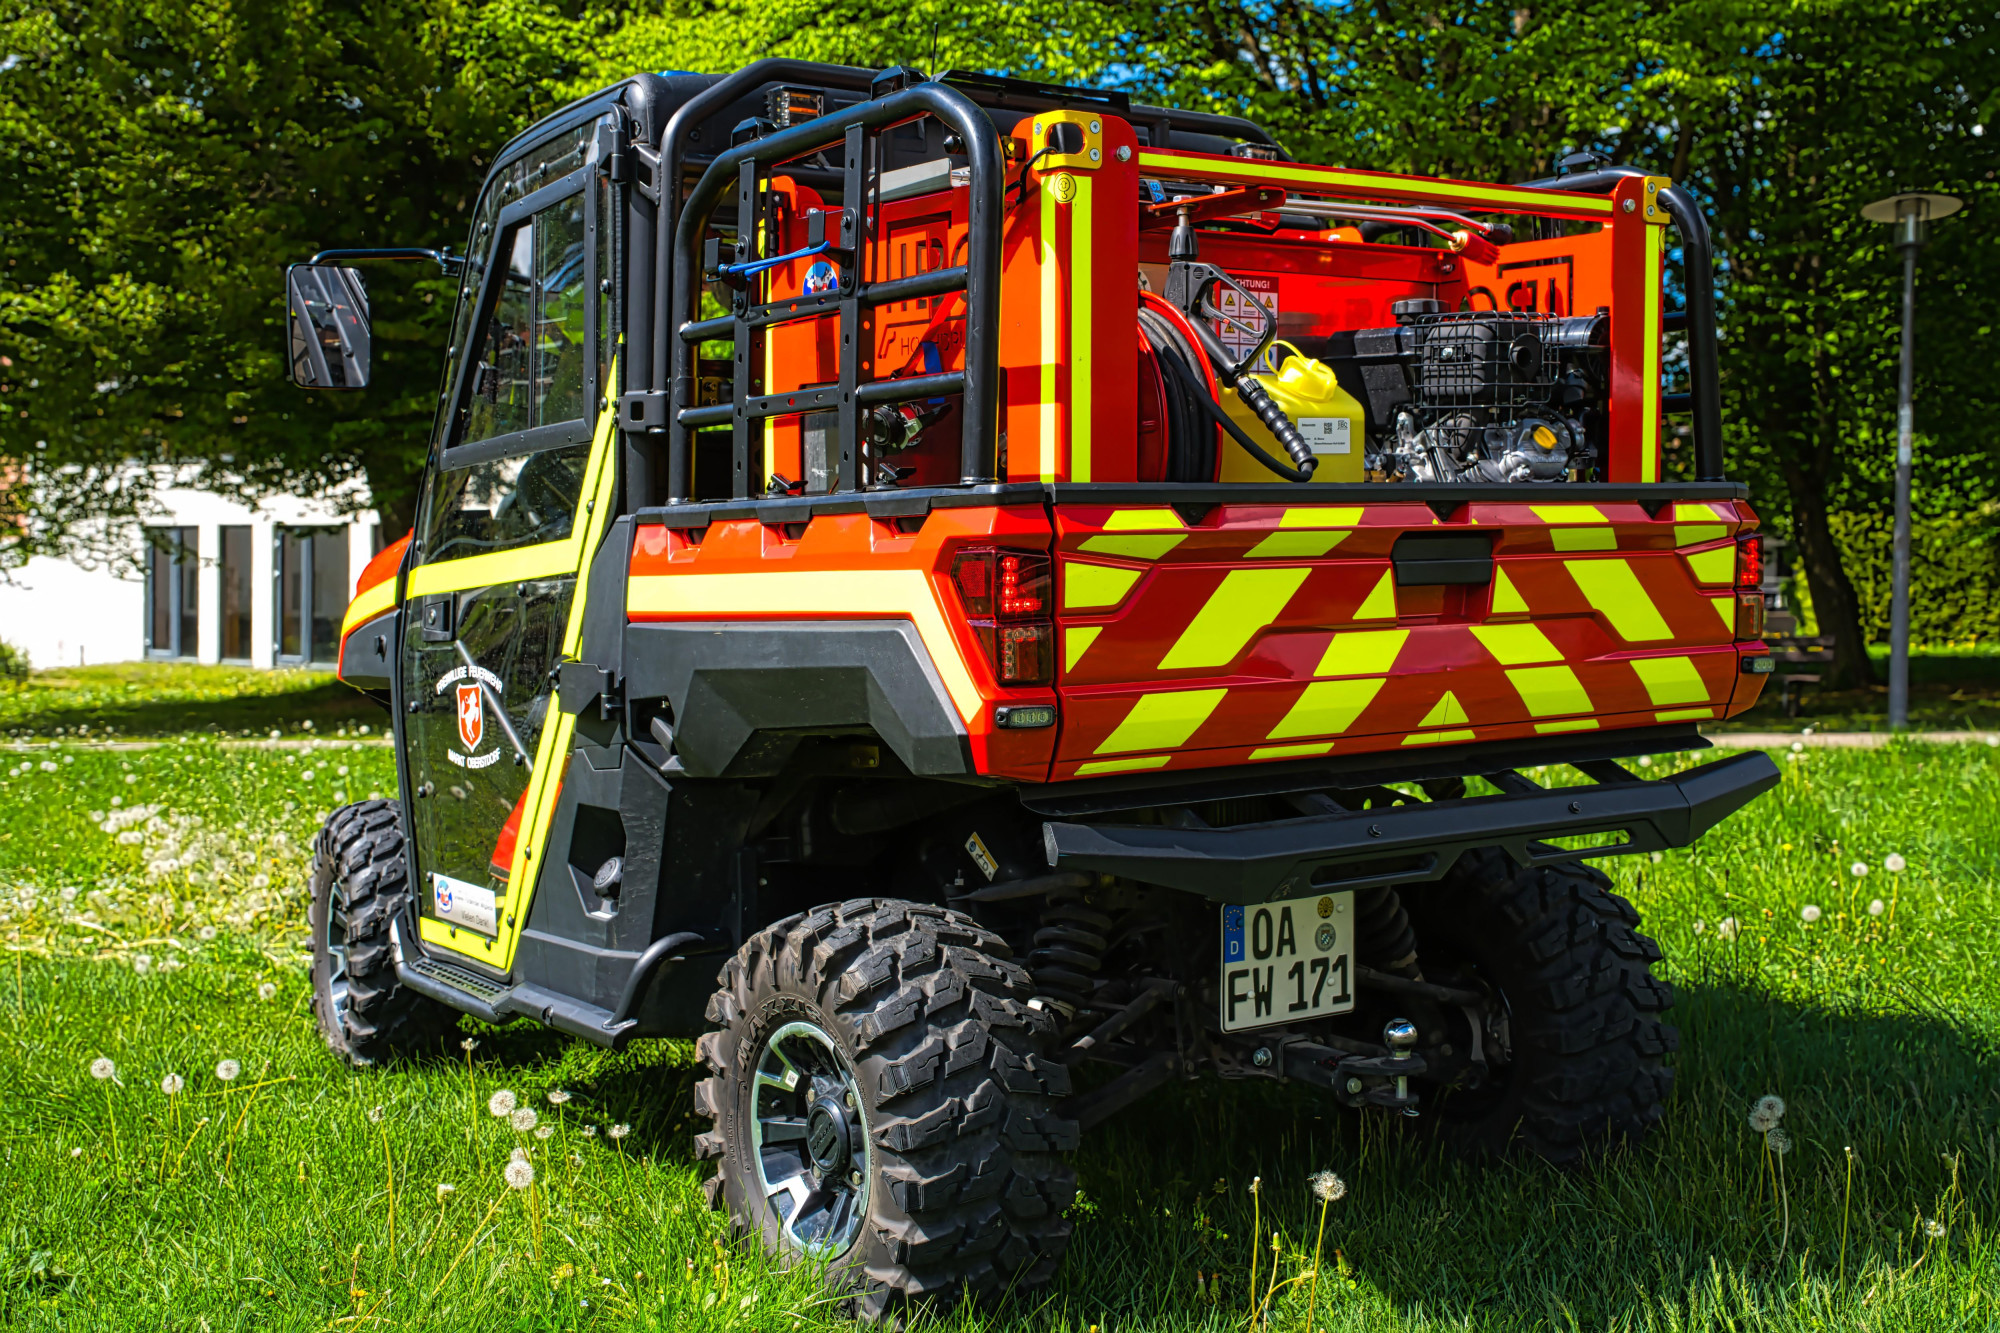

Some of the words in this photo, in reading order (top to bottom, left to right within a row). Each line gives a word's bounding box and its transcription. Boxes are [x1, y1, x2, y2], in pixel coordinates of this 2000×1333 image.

[1235, 278, 1271, 290] CHTUNG!
[436, 665, 468, 695] FREIWILLIGE
[468, 665, 503, 694] FEUERWEHR
[447, 748, 466, 768] MARKT
[467, 746, 501, 769] OBERSTDORF
[1230, 940, 1239, 955] D
[1252, 906, 1297, 960] OA
[1228, 965, 1274, 1022] FW
[1288, 954, 1351, 1013] 171
[736, 996, 823, 1073] MAXXIS
